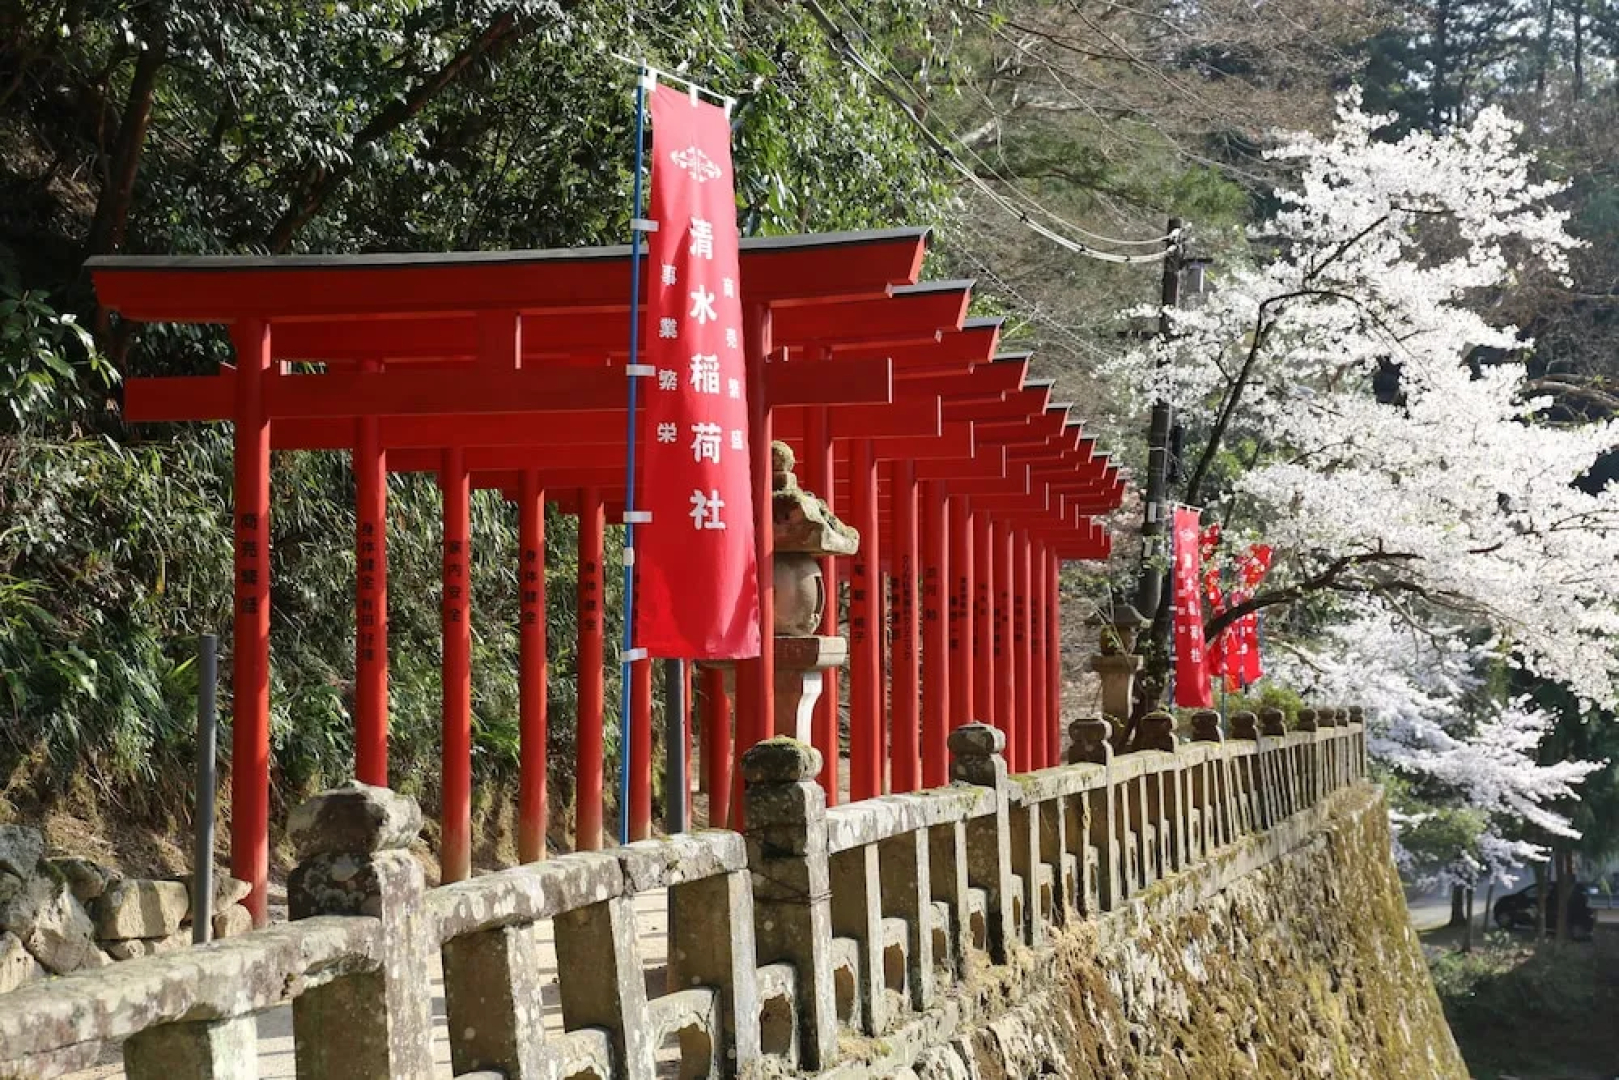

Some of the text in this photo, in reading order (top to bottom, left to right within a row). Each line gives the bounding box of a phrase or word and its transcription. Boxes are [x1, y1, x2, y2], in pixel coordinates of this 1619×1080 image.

[657, 263, 678, 443] 事業繁栄
[689, 216, 726, 530] 清水稲荷社
